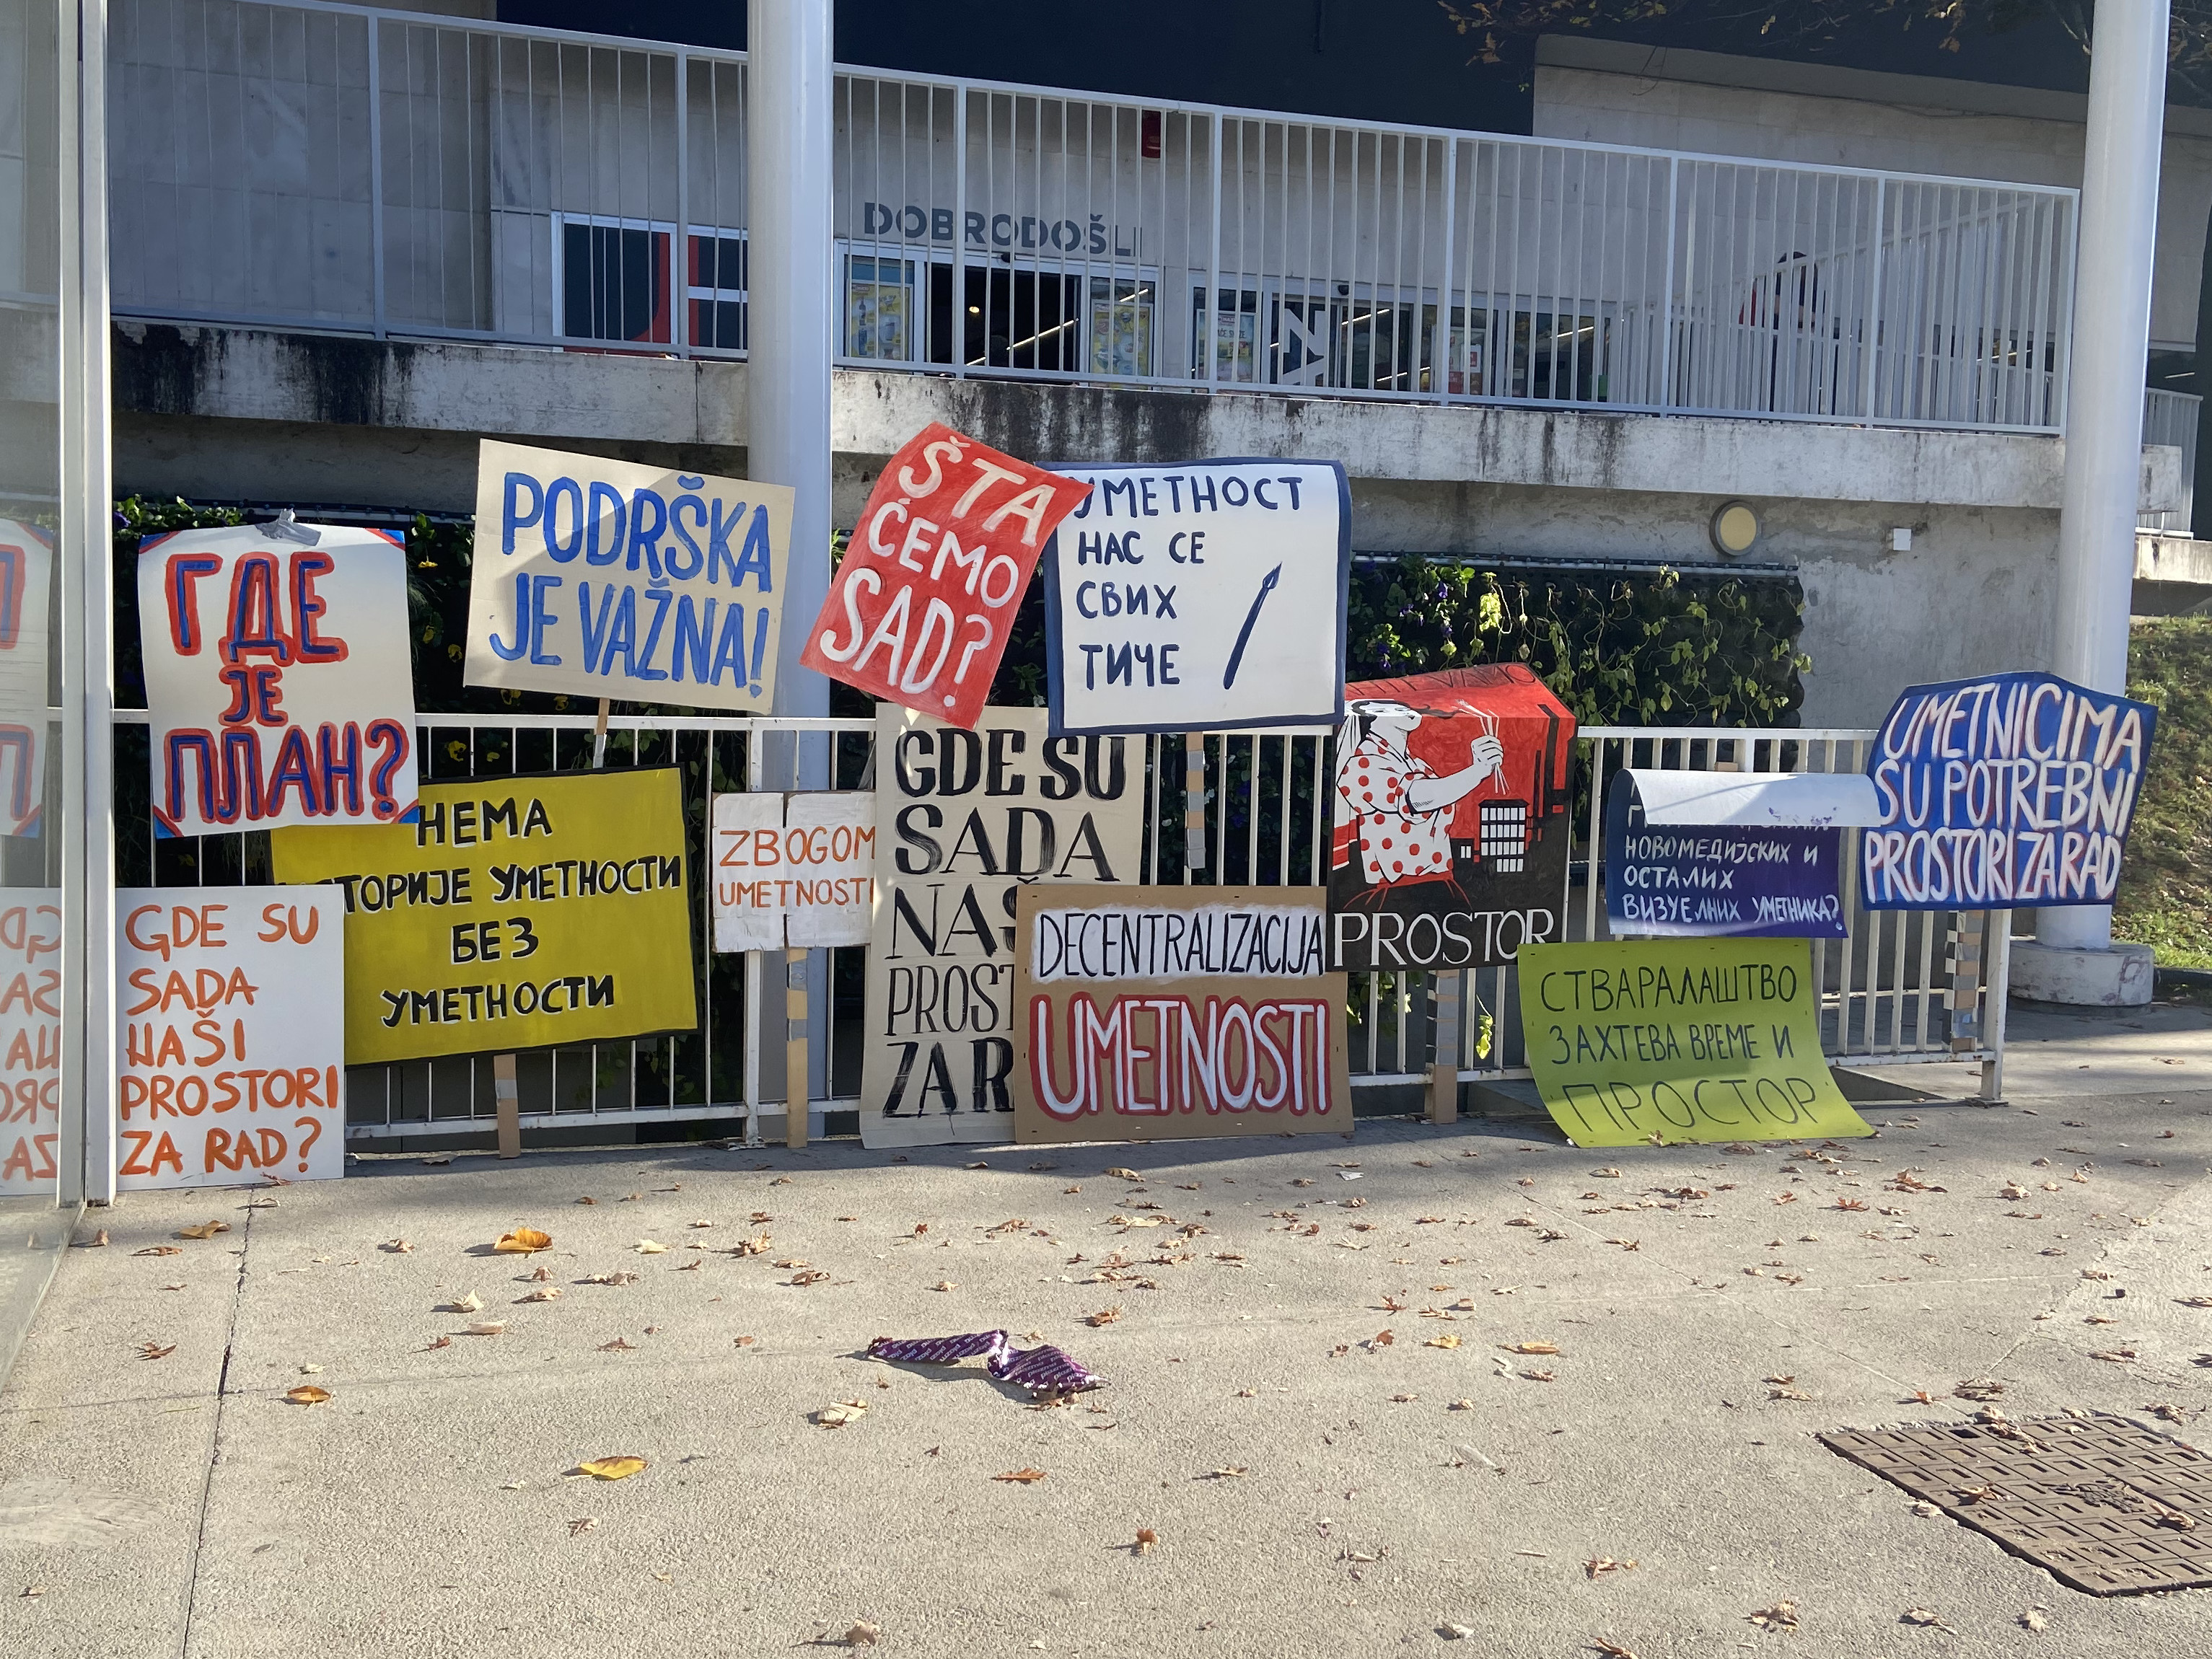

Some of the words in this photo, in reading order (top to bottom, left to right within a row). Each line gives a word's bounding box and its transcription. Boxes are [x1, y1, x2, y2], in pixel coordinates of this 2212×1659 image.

[898, 436, 1057, 547] ŠTA
[502, 472, 772, 593] PODRŠKA
[1078, 531, 1144, 566] НАС
[1169, 532, 1206, 564] СЕ
[164, 551, 349, 666] ГДЕ
[1076, 580, 1177, 620] СВИХ
[489, 573, 563, 665] JE
[579, 577, 770, 698] VAŽNA!
[820, 568, 993, 707] SAD?
[219, 664, 288, 727] ЈЕ
[1079, 641, 1180, 691] ТИЧЕ
[1883, 682, 2142, 773] UMETNICIMA
[164, 718, 409, 824] ПЛАН?
[895, 729, 1027, 798] GDE
[1040, 734, 1127, 800] SU
[416, 797, 553, 848] НЕМА
[1874, 760, 1931, 829] SU
[1943, 758, 2137, 837] POTREBNI
[719, 825, 875, 866] ZBOGOM
[895, 804, 1121, 882] SADA
[1625, 835, 1791, 865] НОВОМЕДИЈСКИХ
[1804, 844, 1818, 866] И
[1865, 826, 2014, 904] PROSTORI
[315, 859, 473, 914] ТОРИЈЕ
[488, 855, 681, 903] УМЕТНОСТИ
[1624, 865, 1734, 889] ОСТАЛИХ
[125, 904, 229, 961] GDE
[257, 903, 320, 945] SU
[450, 917, 540, 964] БЕЗ
[1040, 912, 1325, 977] DECENTRALIZACIJA
[1333, 907, 1554, 967] PROSTOR
[126, 967, 260, 1016] SADA
[379, 974, 615, 1028] УМЕТНОСТИ
[1540, 964, 1797, 1012] СТВАРАЛАШТВО
[1030, 992, 1333, 1122] UMETNOSTI
[1549, 1023, 1681, 1065] ЗАХТЕВА
[1688, 1023, 1761, 1062] ВРЕМЕ
[1771, 1024, 1794, 1060] И
[120, 1065, 339, 1121] PROSTORI
[882, 1041, 964, 1117] ZA
[1561, 1077, 1819, 1133] ПРОСТОР
[119, 1130, 183, 1176] ZA
[204, 1116, 322, 1174] RAD?
